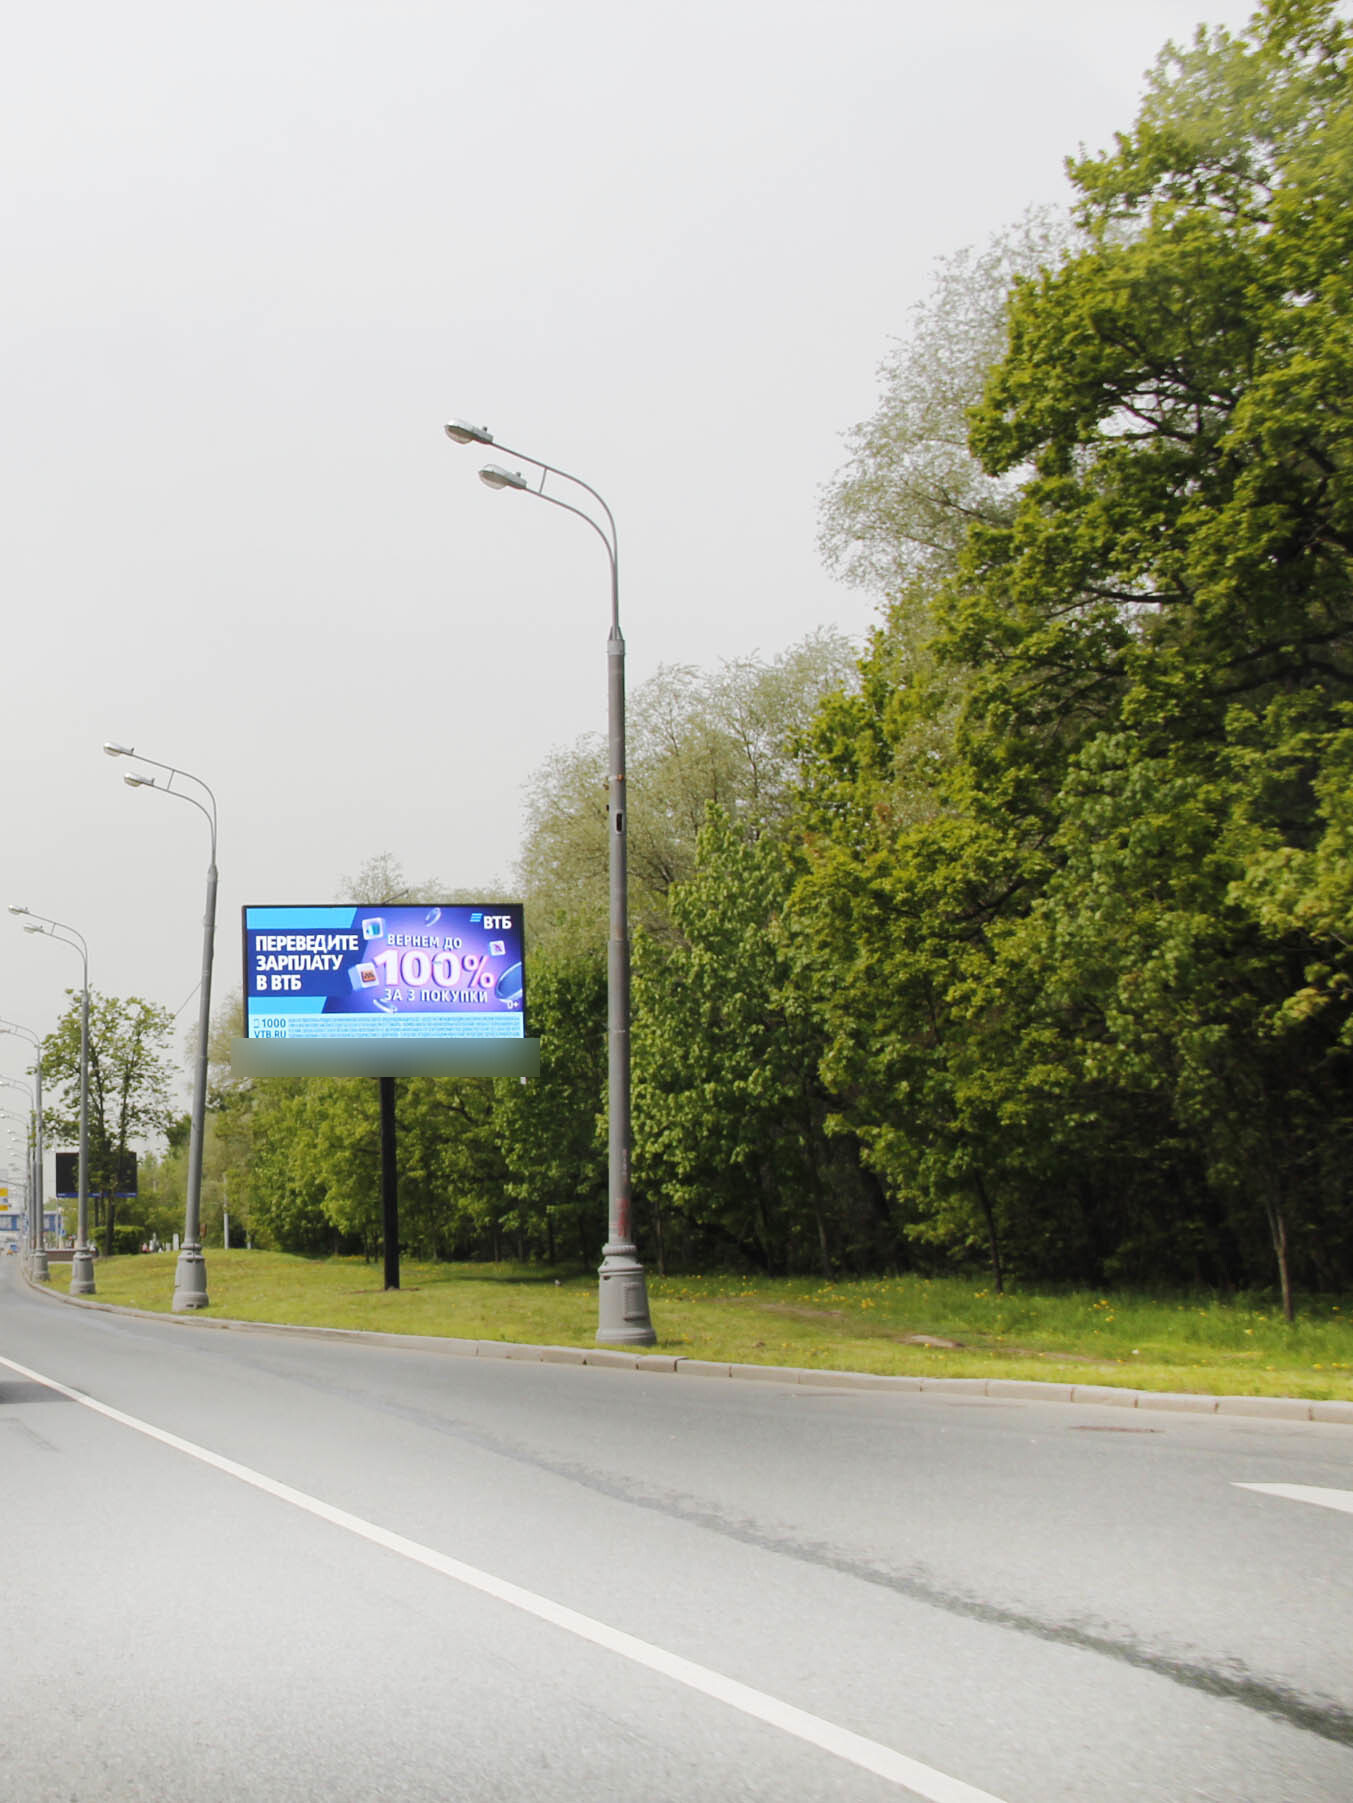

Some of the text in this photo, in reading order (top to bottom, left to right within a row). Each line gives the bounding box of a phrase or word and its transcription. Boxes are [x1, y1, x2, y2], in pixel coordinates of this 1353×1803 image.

[483, 915, 512, 930] ВТБ
[255, 934, 359, 954] ПЕРЕВЕДИТЕ
[387, 933, 463, 951] ВЕРНЕМ ДО
[256, 954, 344, 971] ЗАРПЛАТУ
[373, 948, 497, 988] 100%
[256, 974, 302, 991] В ВТБ
[383, 988, 488, 1003] ЗА 3 ПОКУПКИ
[261, 1018, 287, 1028] 1000
